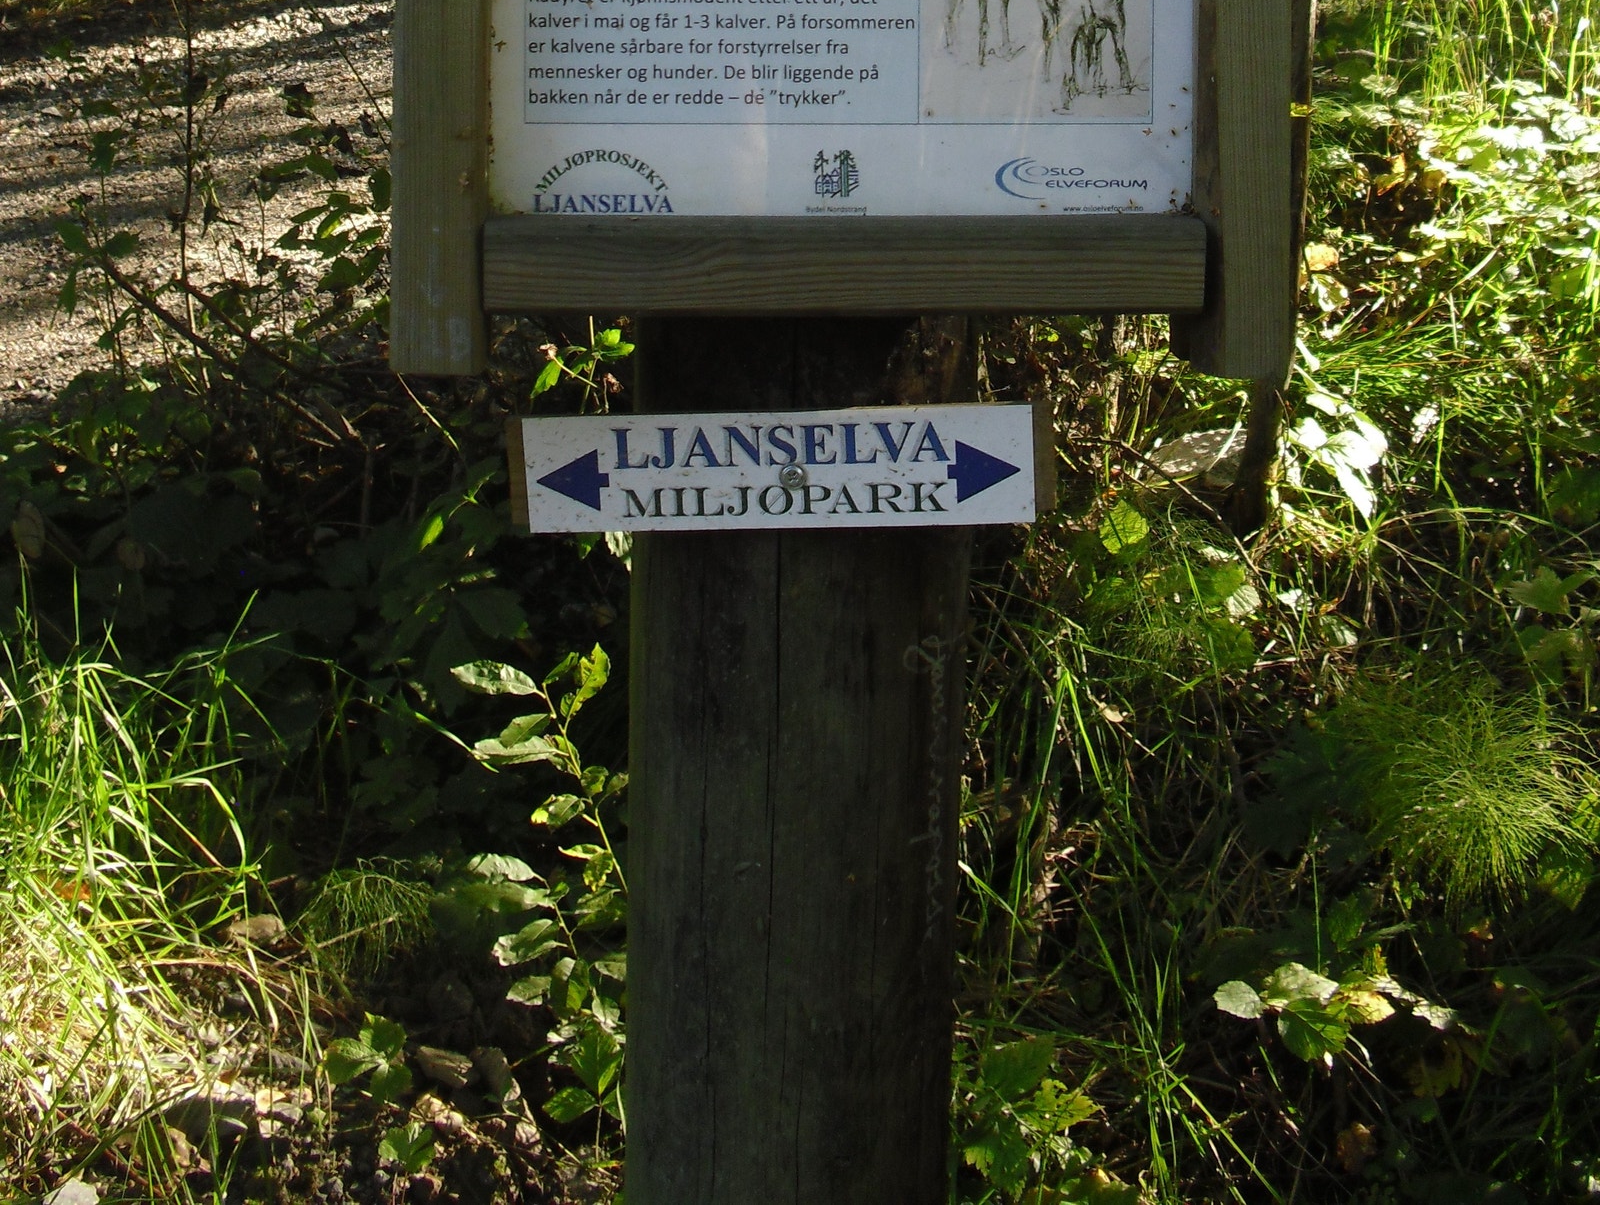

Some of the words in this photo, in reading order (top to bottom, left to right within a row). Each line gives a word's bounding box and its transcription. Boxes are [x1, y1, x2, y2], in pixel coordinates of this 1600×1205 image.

[529, 13, 580, 28] kalver
[594, 14, 624, 30] mai
[630, 18, 650, 32] og
[655, 13, 678, 28] får
[684, 15, 710, 28] 1-3
[716, 14, 770, 29] kalver.
[777, 14, 795, 29] På
[801, 14, 915, 29] forsommeren
[528, 42, 546, 53] er
[551, 38, 615, 53] kalvene
[620, 38, 683, 56] sårbare
[689, 39, 713, 54] for
[718, 39, 821, 57] forstyrrelser
[826, 39, 848, 54] fra
[529, 64, 622, 79] mennesker
[627, 68, 647, 82] og
[653, 64, 717, 79] hunder.
[724, 65, 745, 79] De
[752, 64, 778, 79] blir
[784, 64, 854, 83] liggende
[860, 64, 878, 83] på
[529, 88, 588, 104] bakken
[595, 89, 622, 104] når
[627, 89, 647, 104] de
[652, 94, 670, 104] er
[675, 89, 723, 104] redde
[744, 88, 764, 104] de
[535, 149, 669, 193] MILJØPROSJEKT
[1025, 165, 1084, 176] OSLO
[1045, 179, 1148, 188] ELVEFORUM
[533, 194, 674, 213] LJANSELVA
[611, 421, 951, 470] LJANSELVA
[622, 481, 949, 518] MILJØPARK
